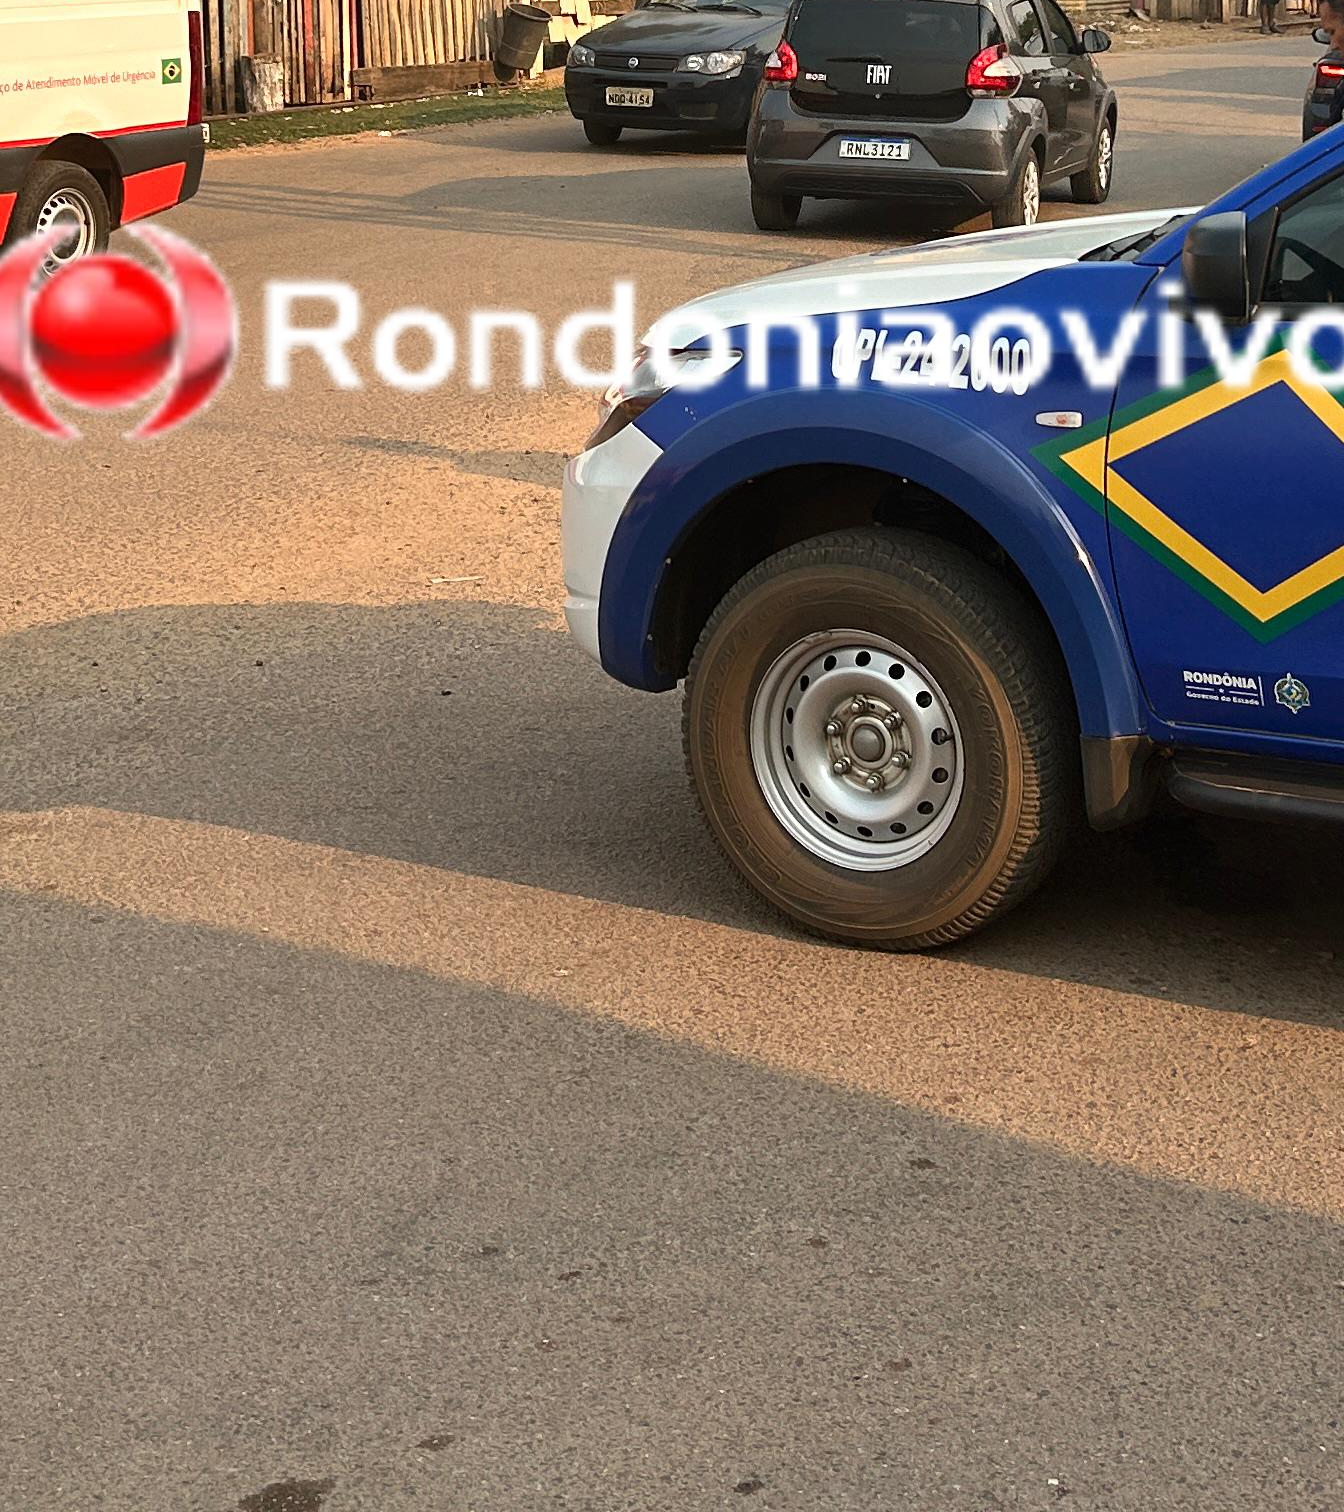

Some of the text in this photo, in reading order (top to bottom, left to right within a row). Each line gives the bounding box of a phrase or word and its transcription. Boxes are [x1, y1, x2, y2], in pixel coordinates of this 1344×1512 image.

[12, 80, 23, 91] de
[26, 76, 81, 90] Atendimento
[83, 72, 108, 86] Móvel
[110, 71, 121, 83] de
[122, 70, 156, 85] Urgência
[866, 65, 892, 85] FIAT
[1183, 670, 1258, 689] RONDÔNIA
